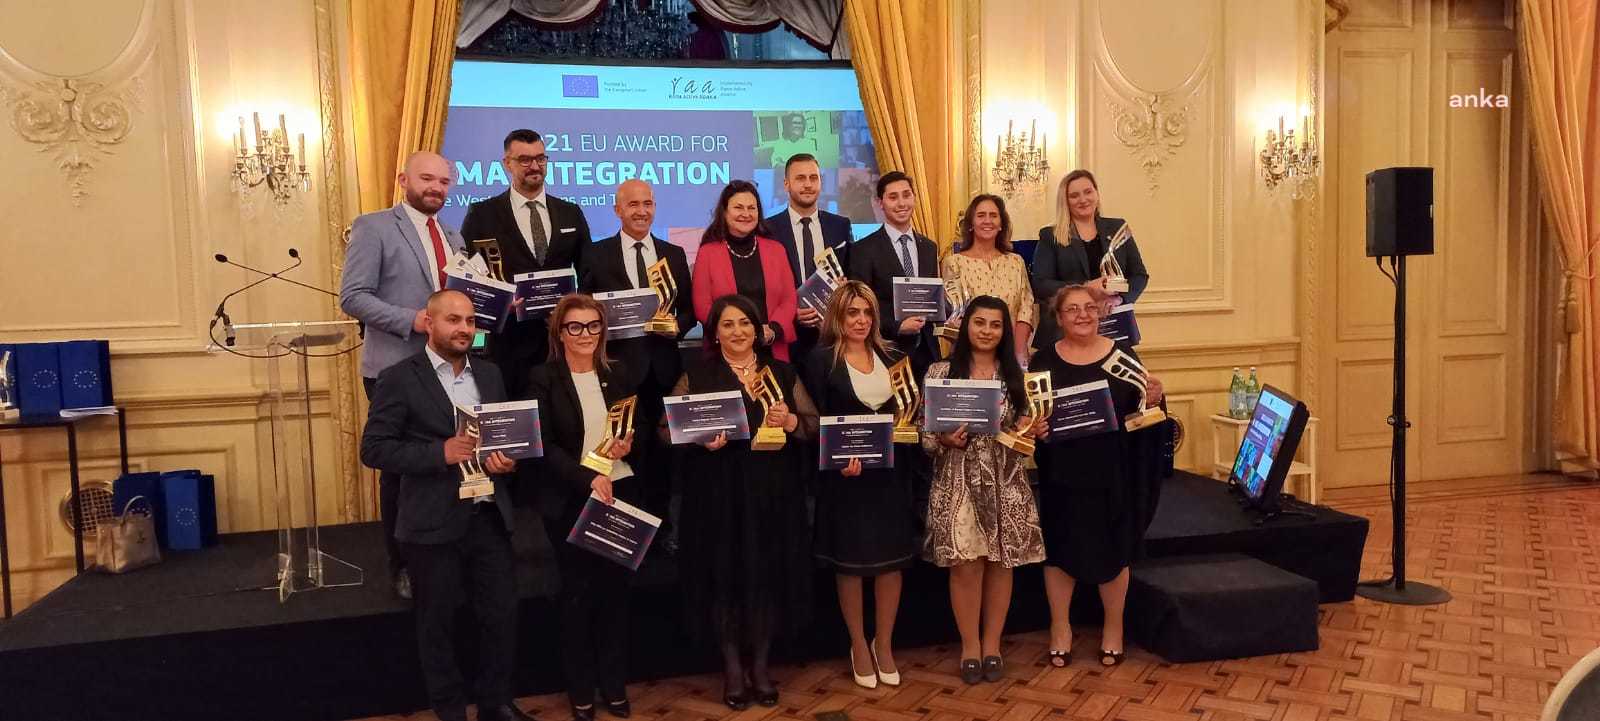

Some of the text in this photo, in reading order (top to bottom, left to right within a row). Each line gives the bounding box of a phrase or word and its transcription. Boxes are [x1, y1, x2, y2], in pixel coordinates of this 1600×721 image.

[541, 134, 728, 152] 21 EU AWARD FOR
[455, 161, 510, 186] MA
[580, 193, 606, 207] and
